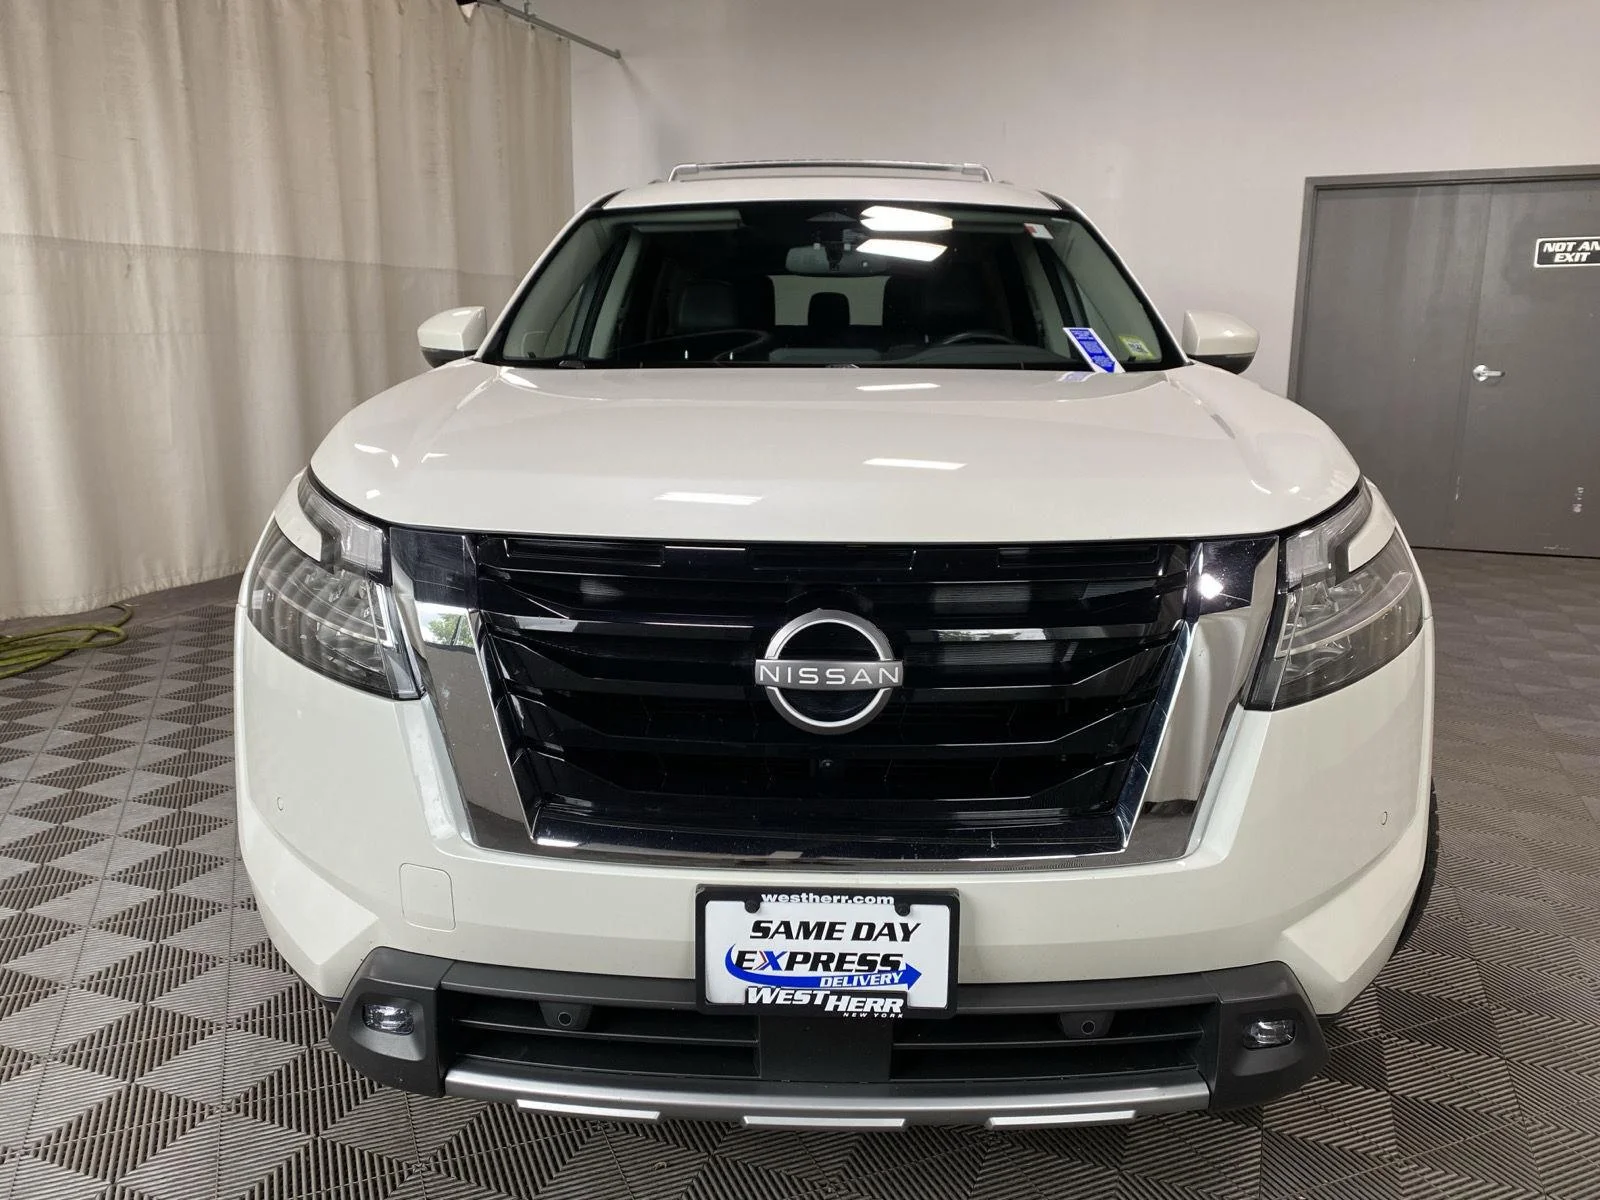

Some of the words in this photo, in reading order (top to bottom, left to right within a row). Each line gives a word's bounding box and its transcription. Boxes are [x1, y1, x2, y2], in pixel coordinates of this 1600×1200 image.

[1543, 242, 1576, 252] NOT
[1554, 252, 1590, 262] EXIT
[759, 665, 899, 685] NISSAN
[761, 892, 895, 905] westherr.com
[749, 919, 847, 941] SAME
[850, 922, 922, 942] DAY
[734, 950, 904, 973] EXPRESS
[819, 972, 902, 988] DELIVERY
